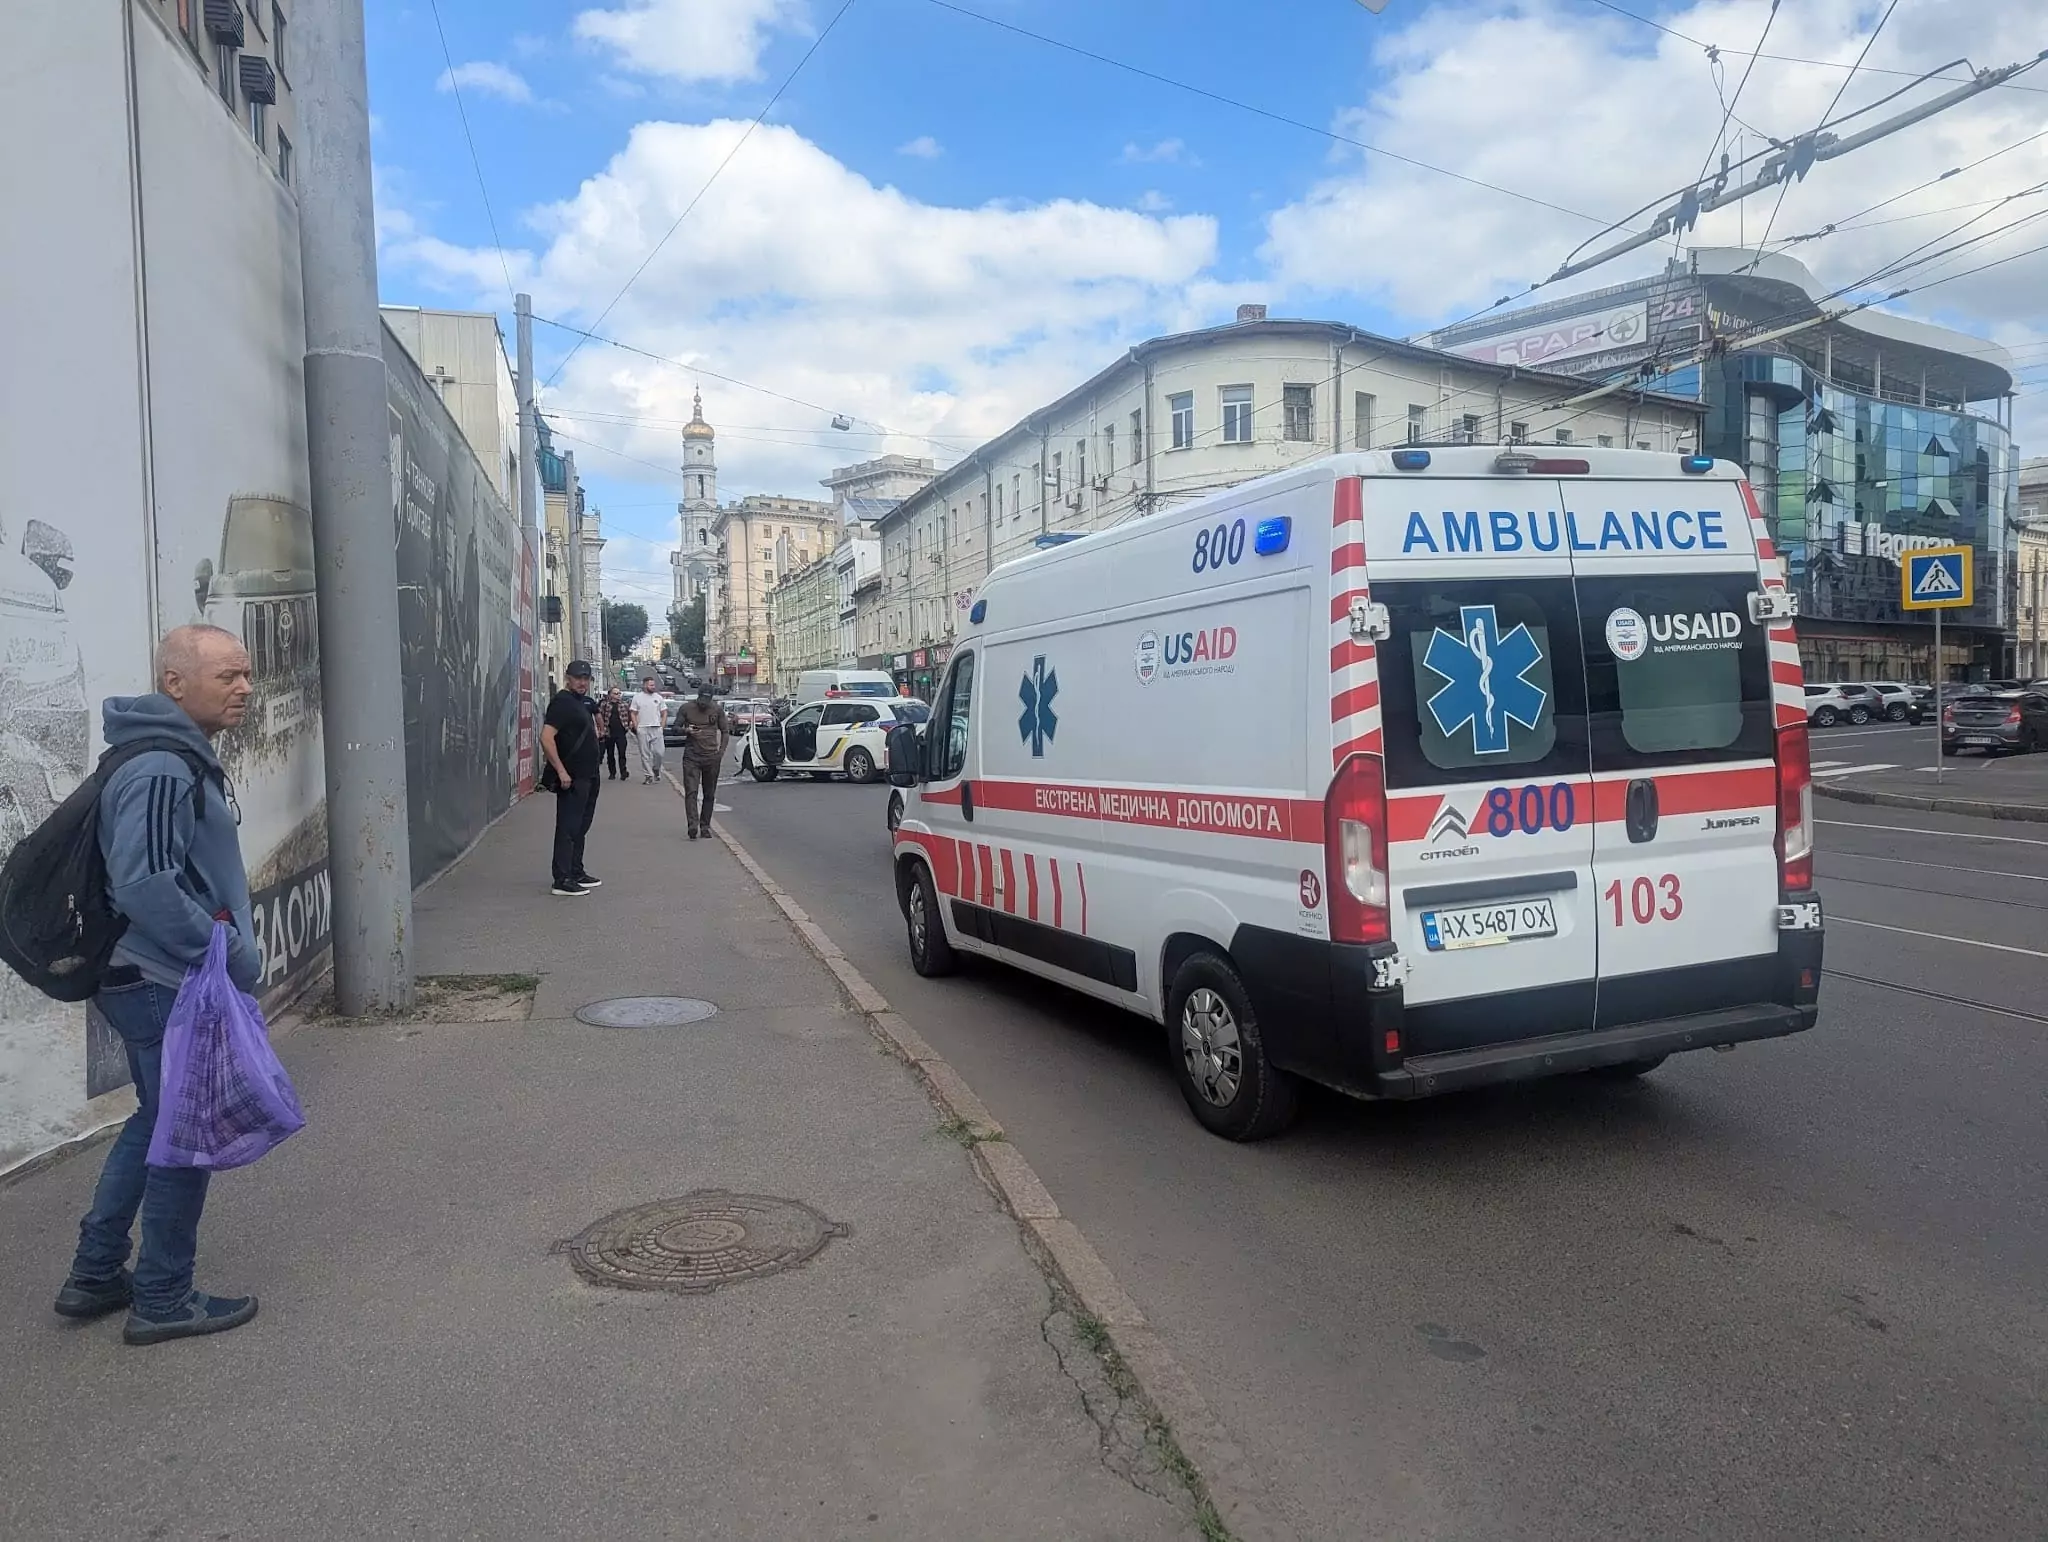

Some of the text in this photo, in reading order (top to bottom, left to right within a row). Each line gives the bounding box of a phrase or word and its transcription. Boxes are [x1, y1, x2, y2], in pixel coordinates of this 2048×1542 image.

[1661, 297, 1694, 321] 24
[1497, 324, 1597, 366] SPAR
[1192, 518, 1246, 574] 800
[1402, 510, 1728, 553] AMBULANCE
[1164, 626, 1237, 665] USAID
[1650, 612, 1742, 641] USAID
[1719, 641, 1743, 650] НАРОДУ
[1035, 788, 1282, 833] ЕКСТРЕНА МЕДИЧНА ДОПОМОГА
[1488, 782, 1575, 838] 800
[1605, 873, 1683, 927] 103
[253, 868, 332, 988] ЗДОРІЖ
[1428, 933, 1440, 942] UA
[1472, 908, 1517, 935] 5487
